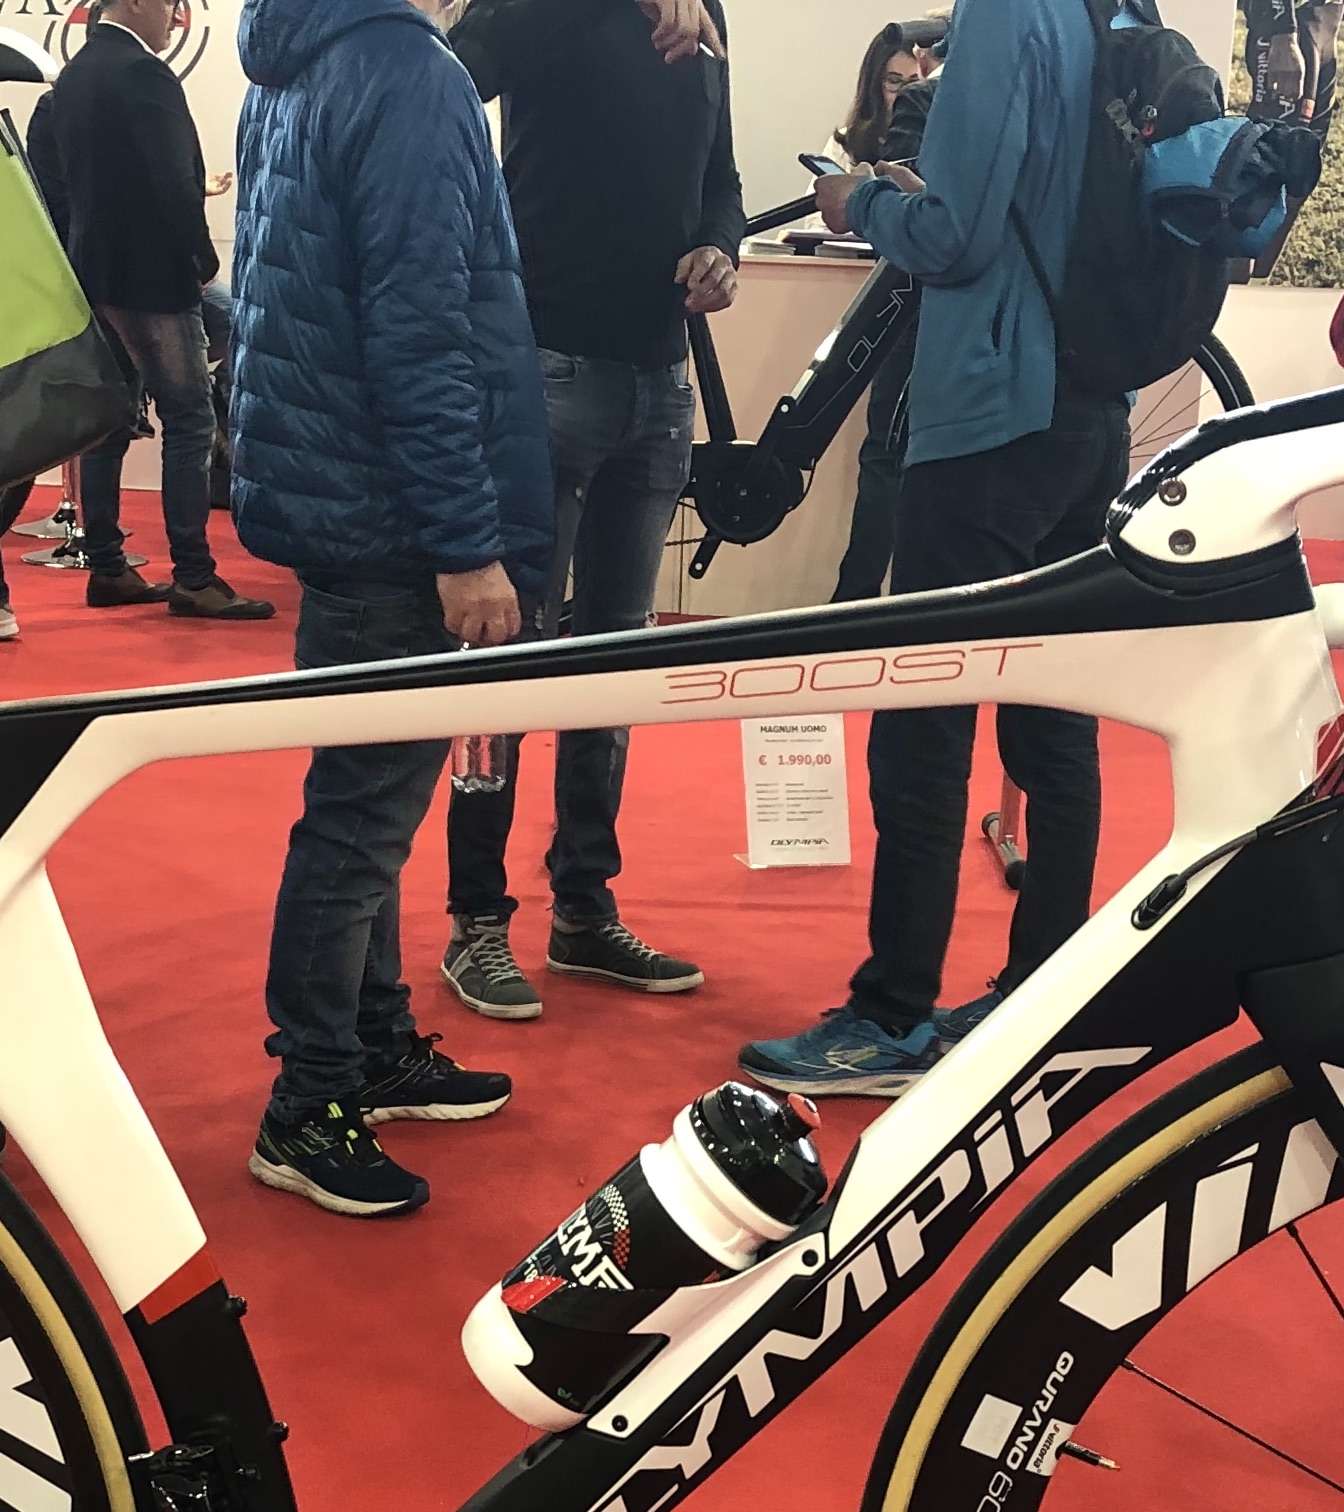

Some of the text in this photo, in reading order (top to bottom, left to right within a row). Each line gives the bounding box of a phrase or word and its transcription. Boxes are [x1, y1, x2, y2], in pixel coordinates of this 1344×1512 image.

[659, 643, 1043, 705] BOOST
[760, 724, 827, 734] MAGNUM UOMO
[758, 753, 832, 767] € 1.990,00
[1006, 1350, 1075, 1471] QURANO
[1032, 1431, 1057, 1470] vittoria
